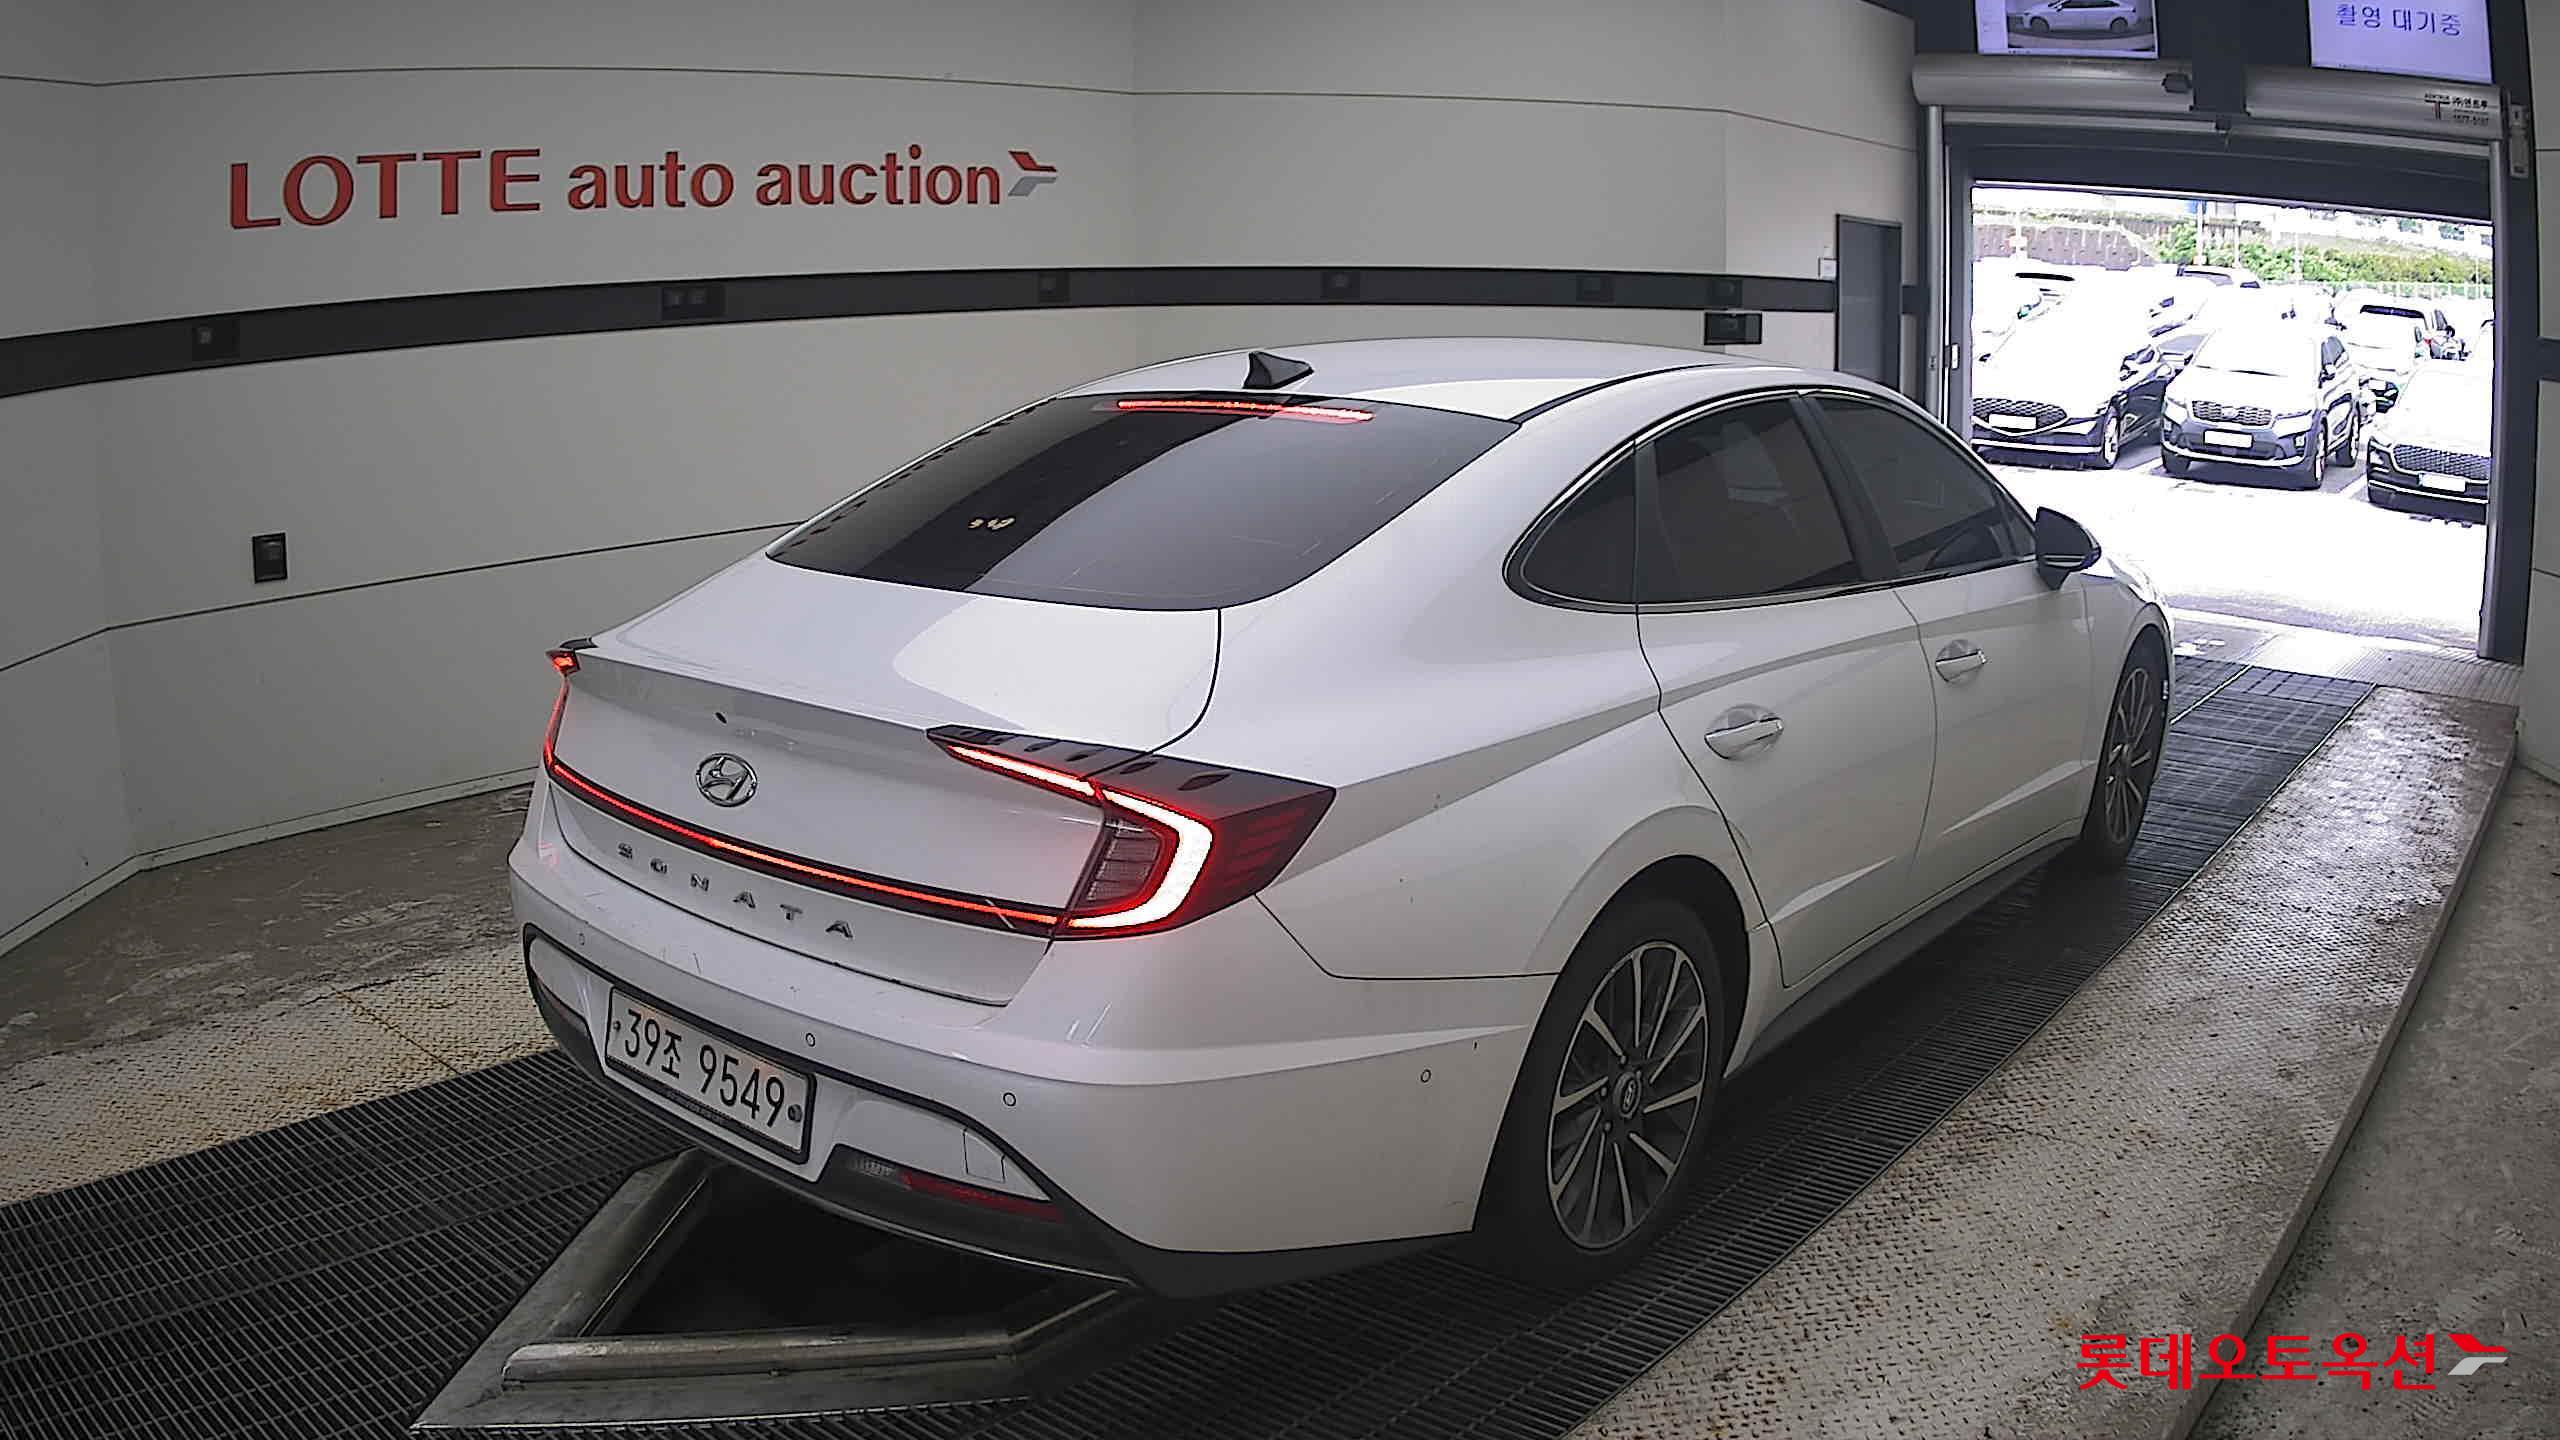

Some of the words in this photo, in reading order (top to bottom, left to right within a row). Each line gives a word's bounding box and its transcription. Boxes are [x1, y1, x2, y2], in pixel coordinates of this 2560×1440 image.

[2336, 4, 2381, 29] 촬영
[2393, 9, 2461, 36] 대기중
[230, 149, 541, 229] LOTTE
[566, 151, 735, 209] auto
[756, 145, 1001, 206] auction
[618, 842, 853, 938] SONATA
[625, 1008, 682, 1079] 39조
[700, 1044, 785, 1127] 9549
